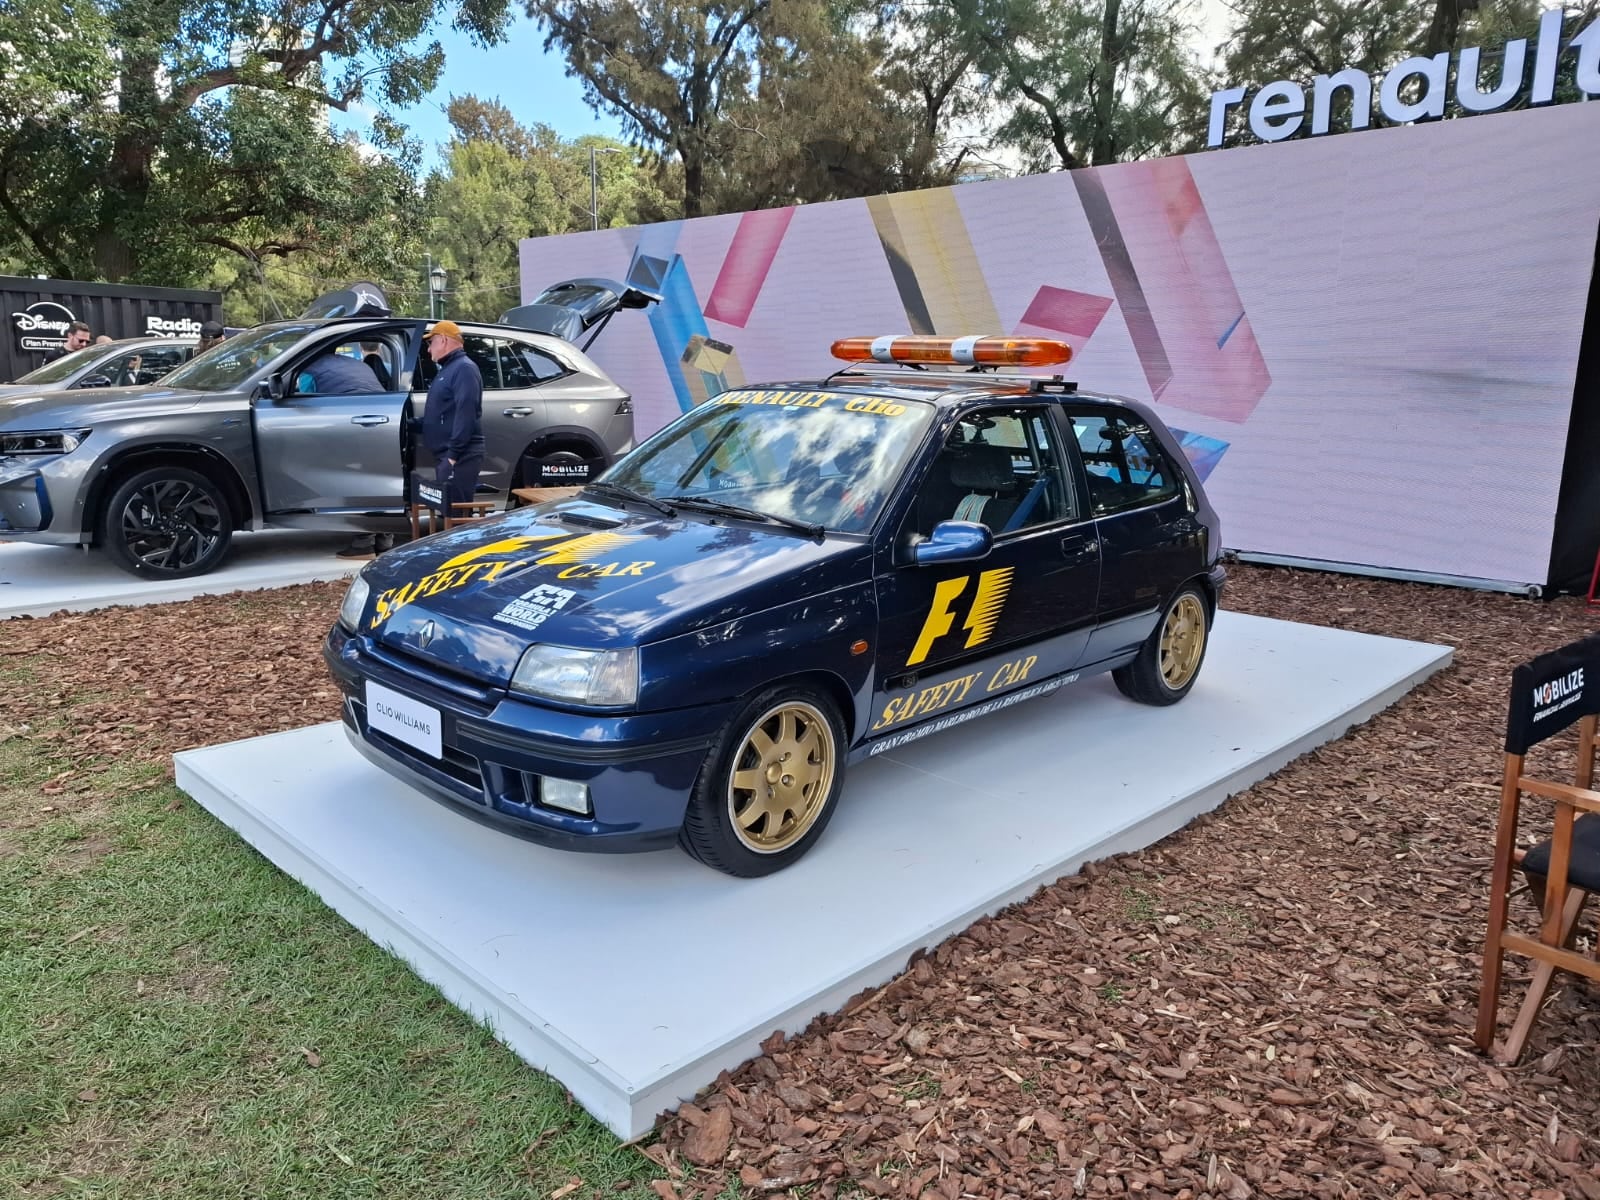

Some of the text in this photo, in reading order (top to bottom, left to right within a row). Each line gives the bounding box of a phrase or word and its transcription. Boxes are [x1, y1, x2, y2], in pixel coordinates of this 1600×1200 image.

[1207, 8, 1600, 147] renault
[147, 316, 202, 332] Radio
[715, 391, 908, 417] RENAULT Clio
[542, 464, 589, 473] MOBILIZE
[371, 560, 655, 629] SAFETY CAR
[502, 604, 548, 624] WORLD
[906, 567, 1015, 666] F1
[872, 655, 1038, 730] SAFETY CAR
[1533, 668, 1584, 708] MOBILIZE
[376, 702, 431, 735] CLIO WILLIAMS
[870, 735, 901, 756] GRAN
